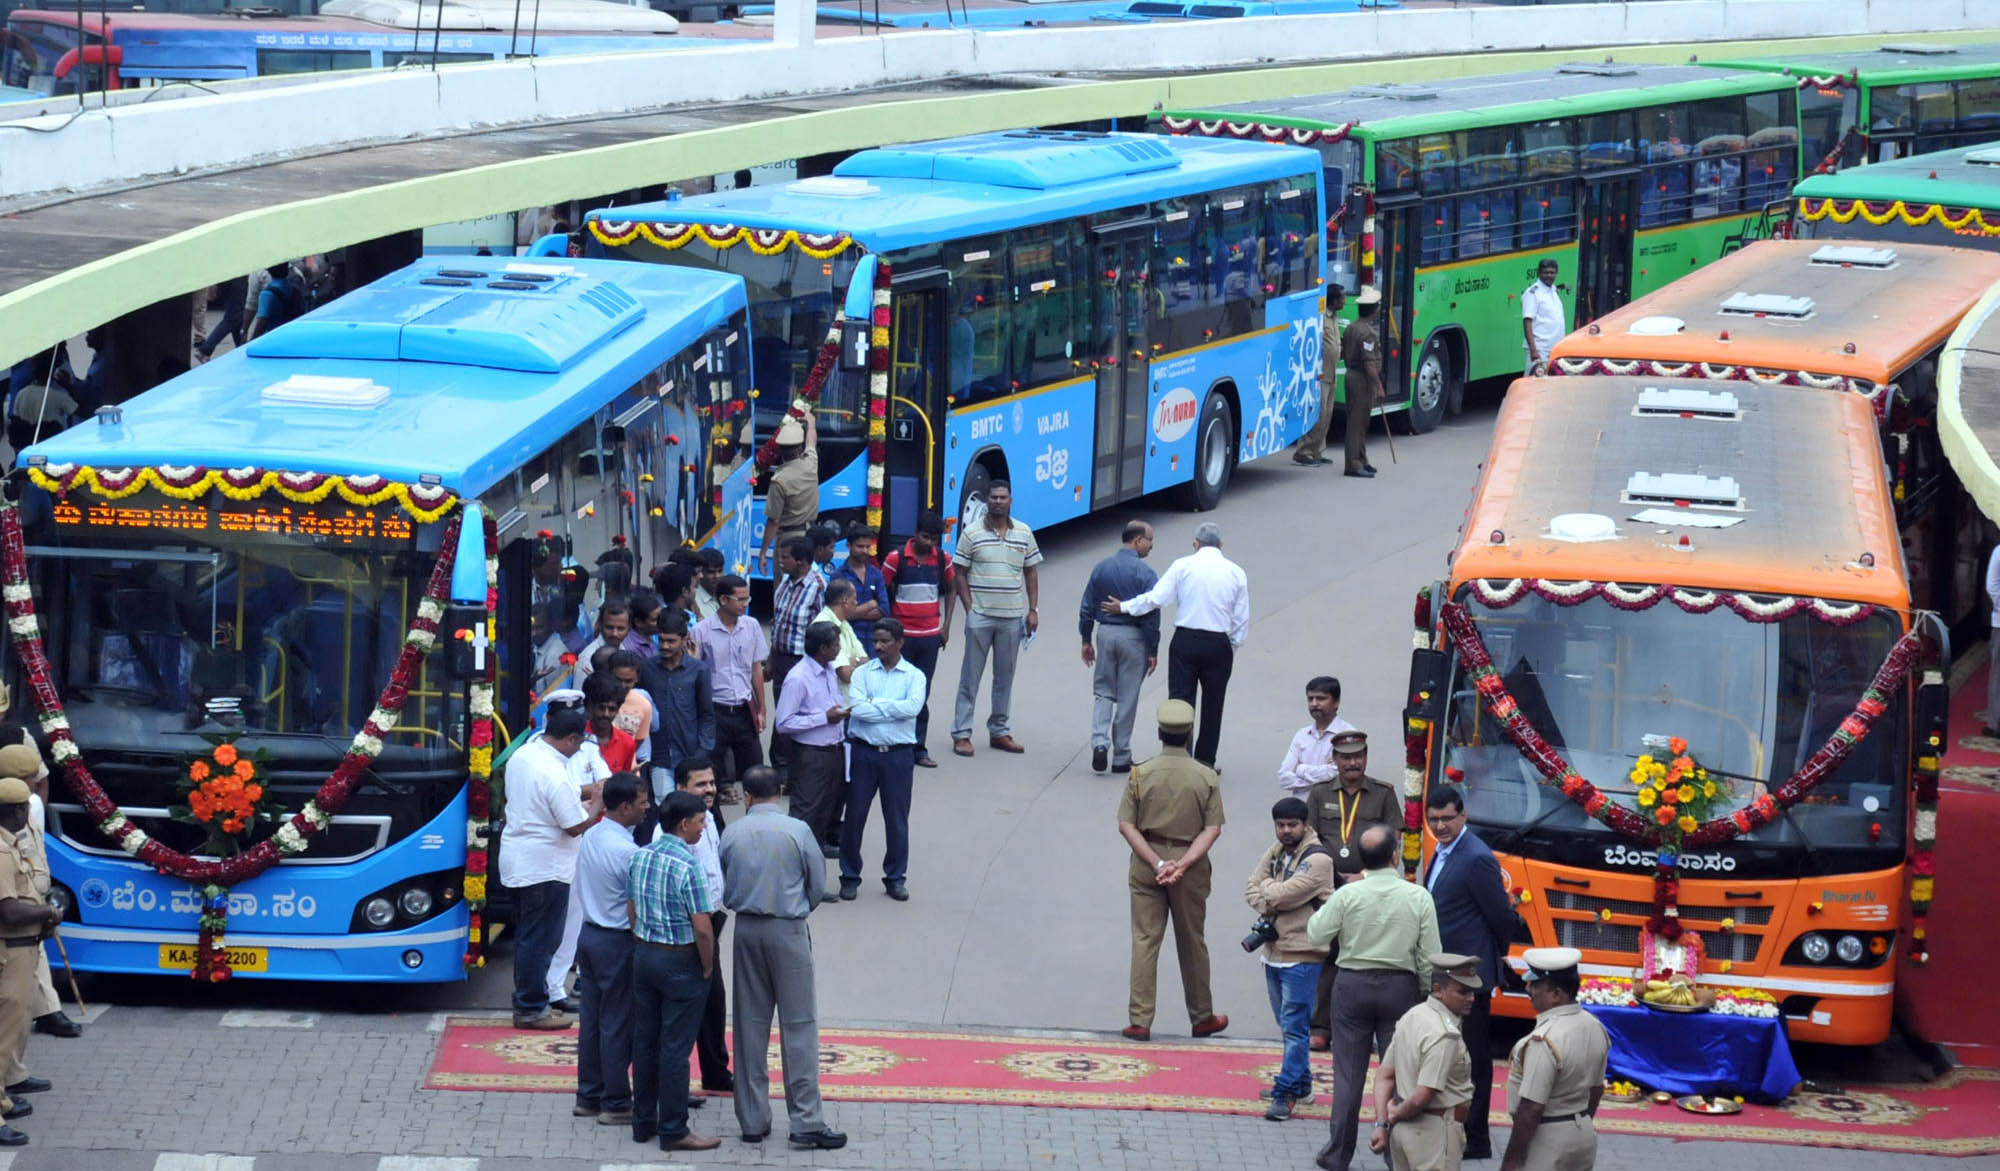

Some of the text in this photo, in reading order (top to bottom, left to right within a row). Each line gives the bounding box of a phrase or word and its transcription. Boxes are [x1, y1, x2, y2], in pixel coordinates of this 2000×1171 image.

[971, 413, 1003, 440] BMTC
[1037, 409, 1069, 435] VAJRA
[1035, 443, 1069, 490] ವಜ್ರ
